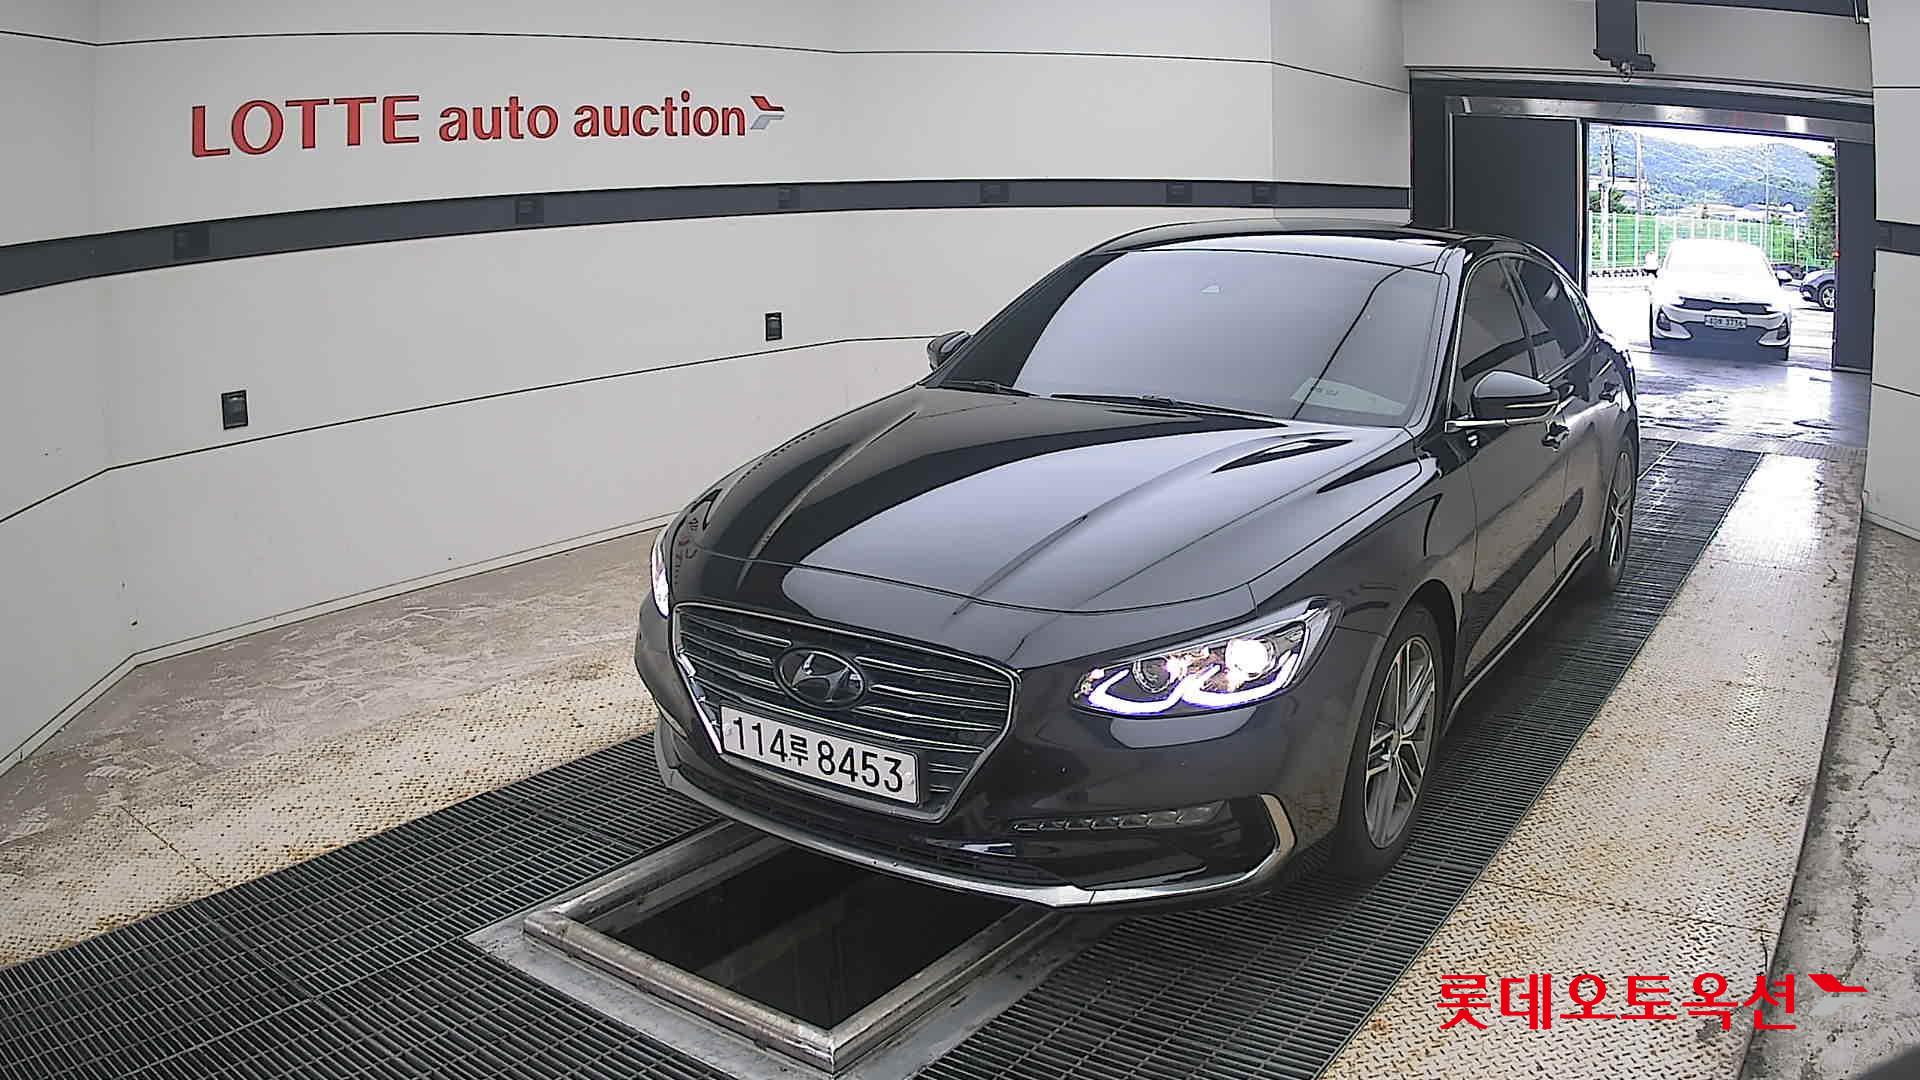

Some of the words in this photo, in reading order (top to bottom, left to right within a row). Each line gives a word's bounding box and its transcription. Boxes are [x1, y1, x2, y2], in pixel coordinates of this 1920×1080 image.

[192, 95, 420, 158] LOTTE
[438, 96, 559, 142] auto
[573, 90, 746, 138] auction
[733, 716, 808, 767] 114루
[817, 740, 904, 793] 8453
